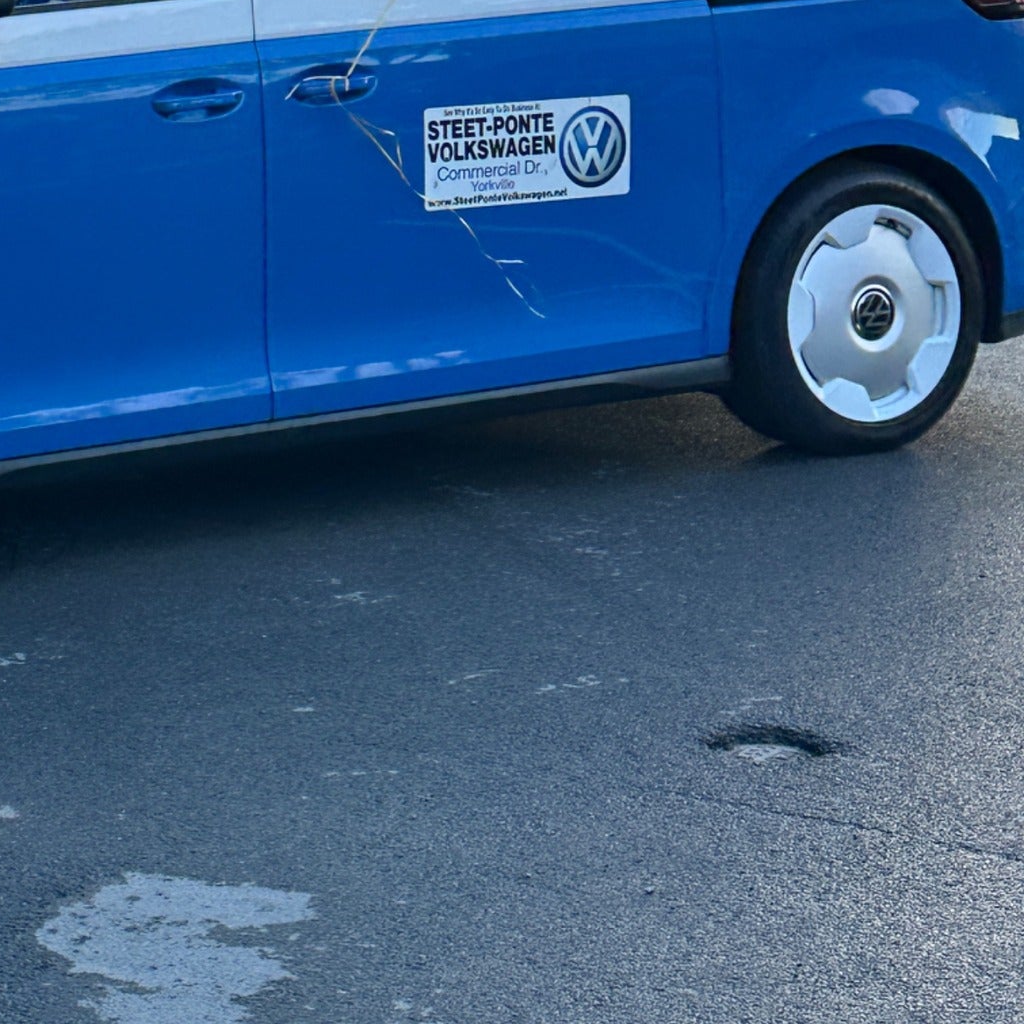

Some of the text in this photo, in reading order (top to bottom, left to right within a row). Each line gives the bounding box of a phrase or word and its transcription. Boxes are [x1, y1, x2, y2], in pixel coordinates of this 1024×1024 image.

[428, 134, 556, 163] VOLKSWAGEN
[437, 161, 520, 182] Commercial
[471, 178, 516, 192] Yorkville
